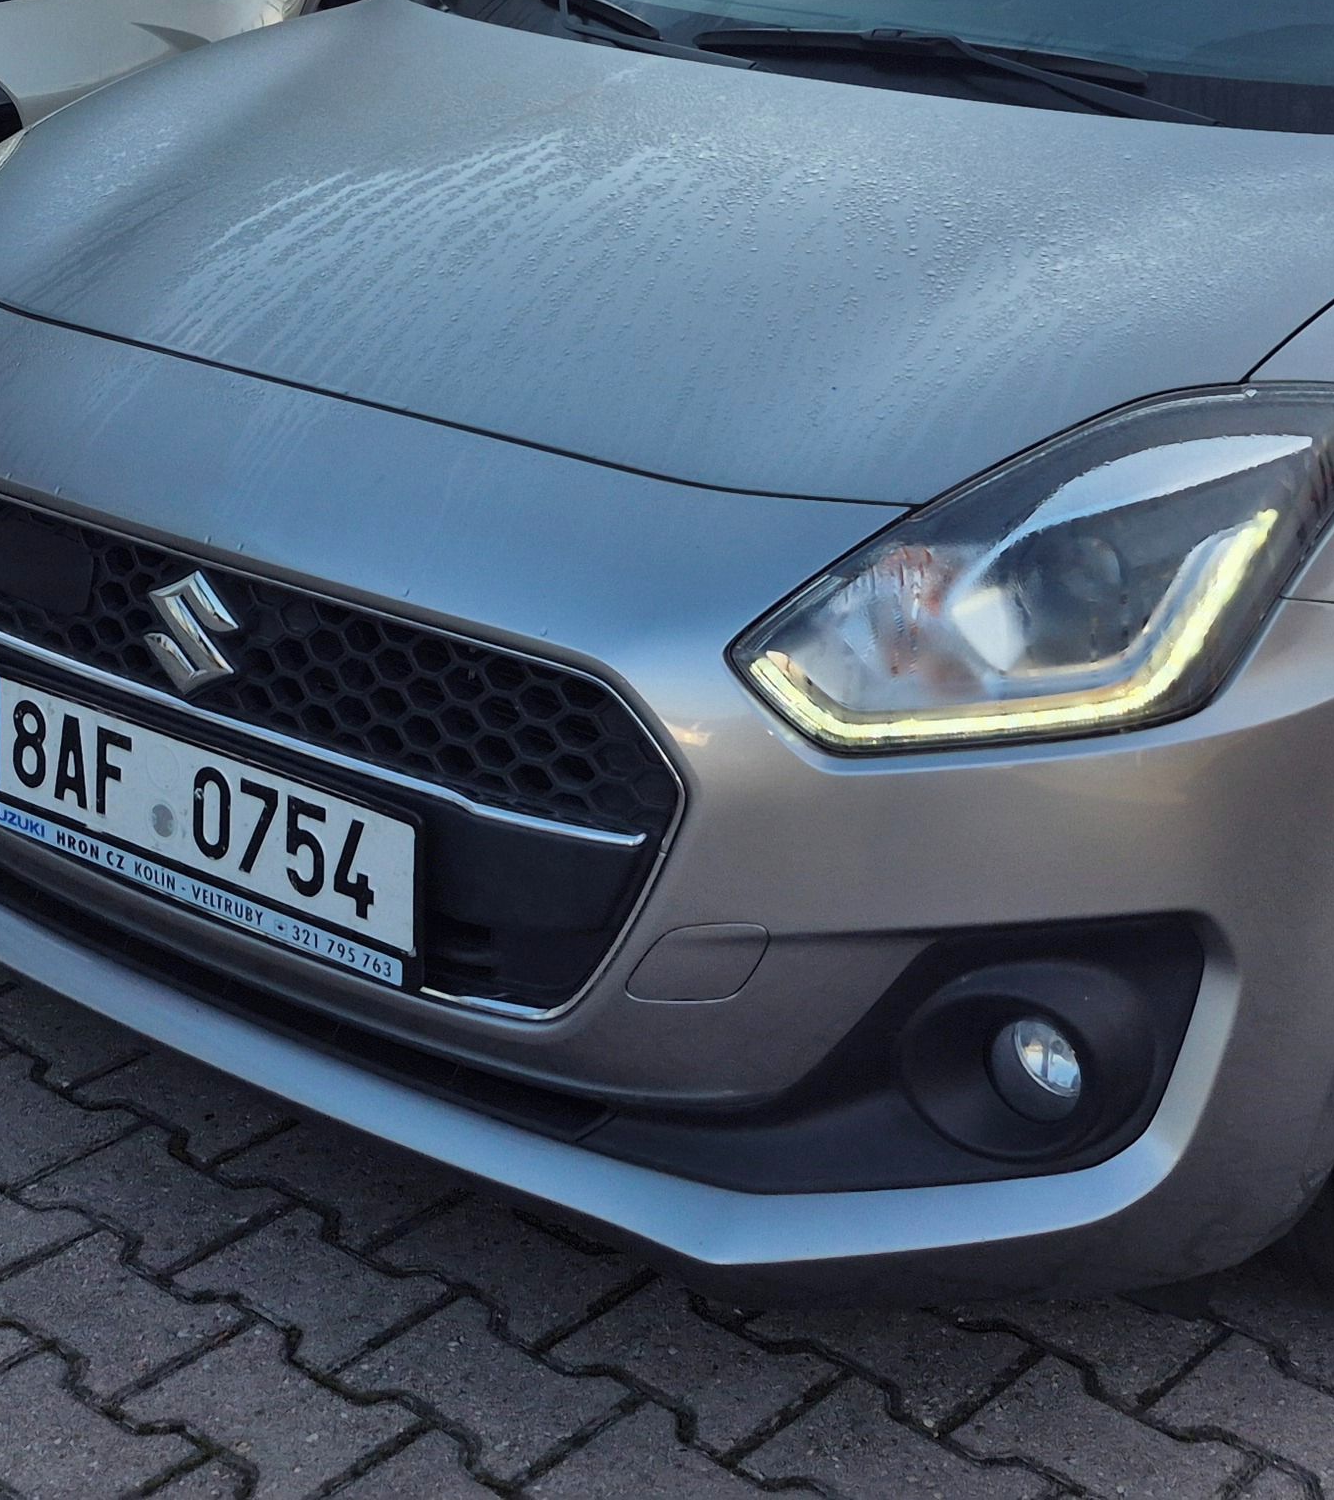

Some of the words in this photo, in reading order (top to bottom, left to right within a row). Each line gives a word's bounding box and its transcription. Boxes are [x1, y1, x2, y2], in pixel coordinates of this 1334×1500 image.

[12, 700, 132, 815] 8AF
[192, 766, 375, 920] 0754
[56, 830, 99, 860] HRON
[107, 850, 125, 869] CZ
[134, 861, 175, 891] KOLÍN
[191, 884, 264, 926] VELTRUBY
[292, 925, 319, 948] 321
[327, 939, 355, 963] 795
[363, 953, 391, 977] 763
